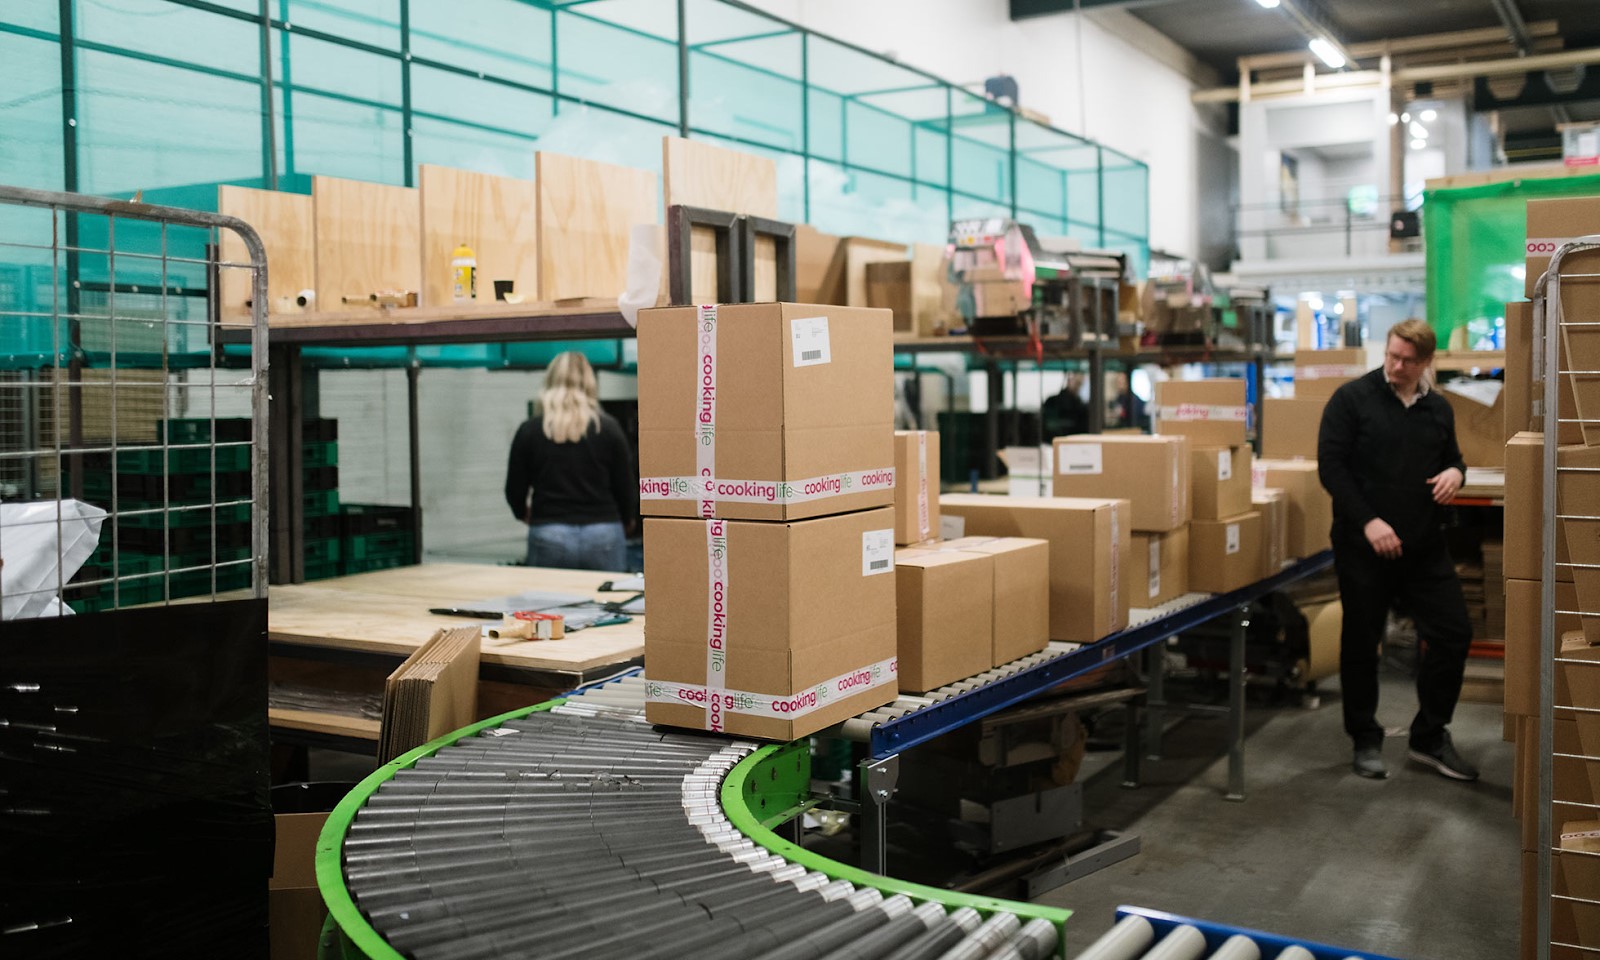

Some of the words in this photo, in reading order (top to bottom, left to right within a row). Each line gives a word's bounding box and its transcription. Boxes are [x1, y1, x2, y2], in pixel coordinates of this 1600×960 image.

[699, 354, 715, 446] cookinglife
[717, 481, 793, 502] cookinglife
[804, 474, 852, 495] cookinglife
[861, 469, 893, 486] cooking
[709, 581, 726, 672] cookinglife
[771, 684, 828, 713] cookinglife
[837, 664, 881, 691] cookinglife
